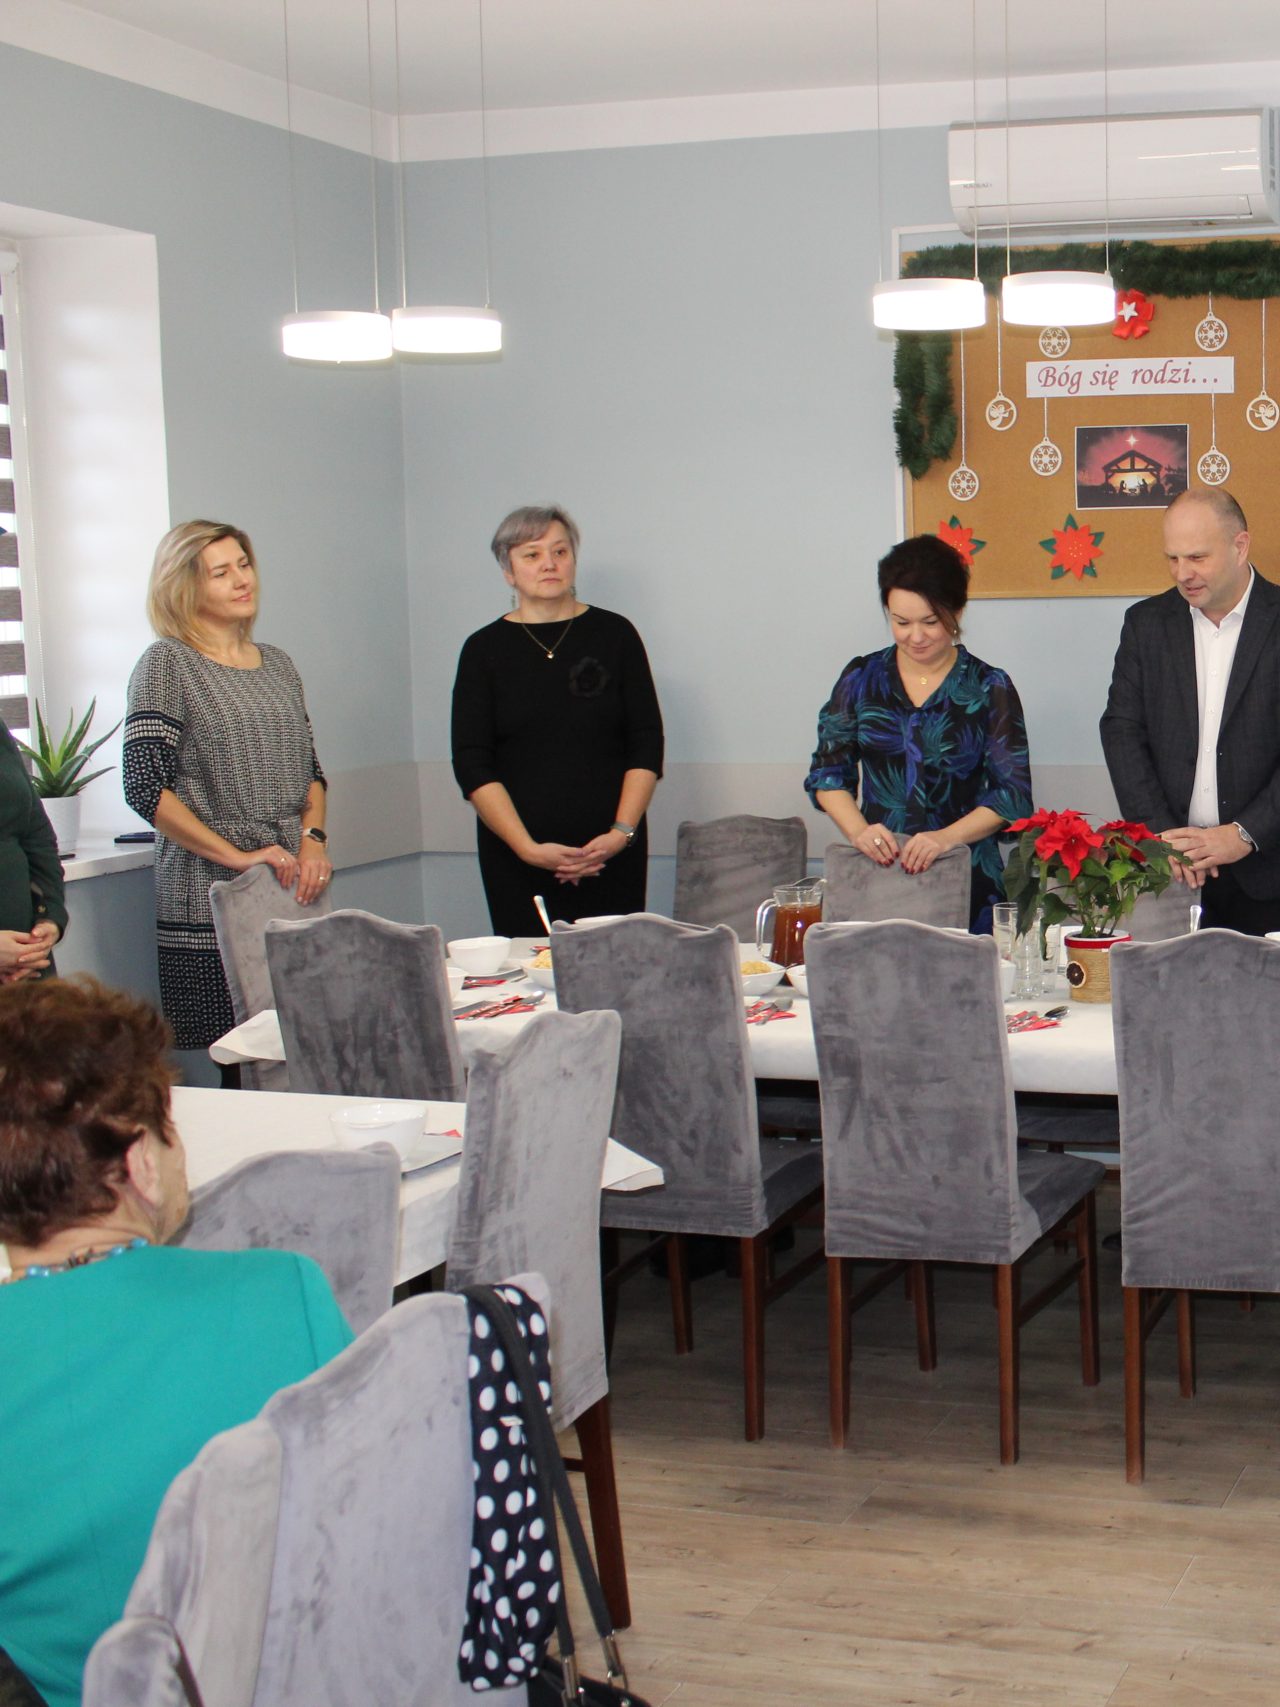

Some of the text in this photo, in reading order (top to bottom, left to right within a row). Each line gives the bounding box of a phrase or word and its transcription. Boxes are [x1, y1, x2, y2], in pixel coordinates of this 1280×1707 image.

[1038, 359, 1219, 395] Bóg się rodzi...
